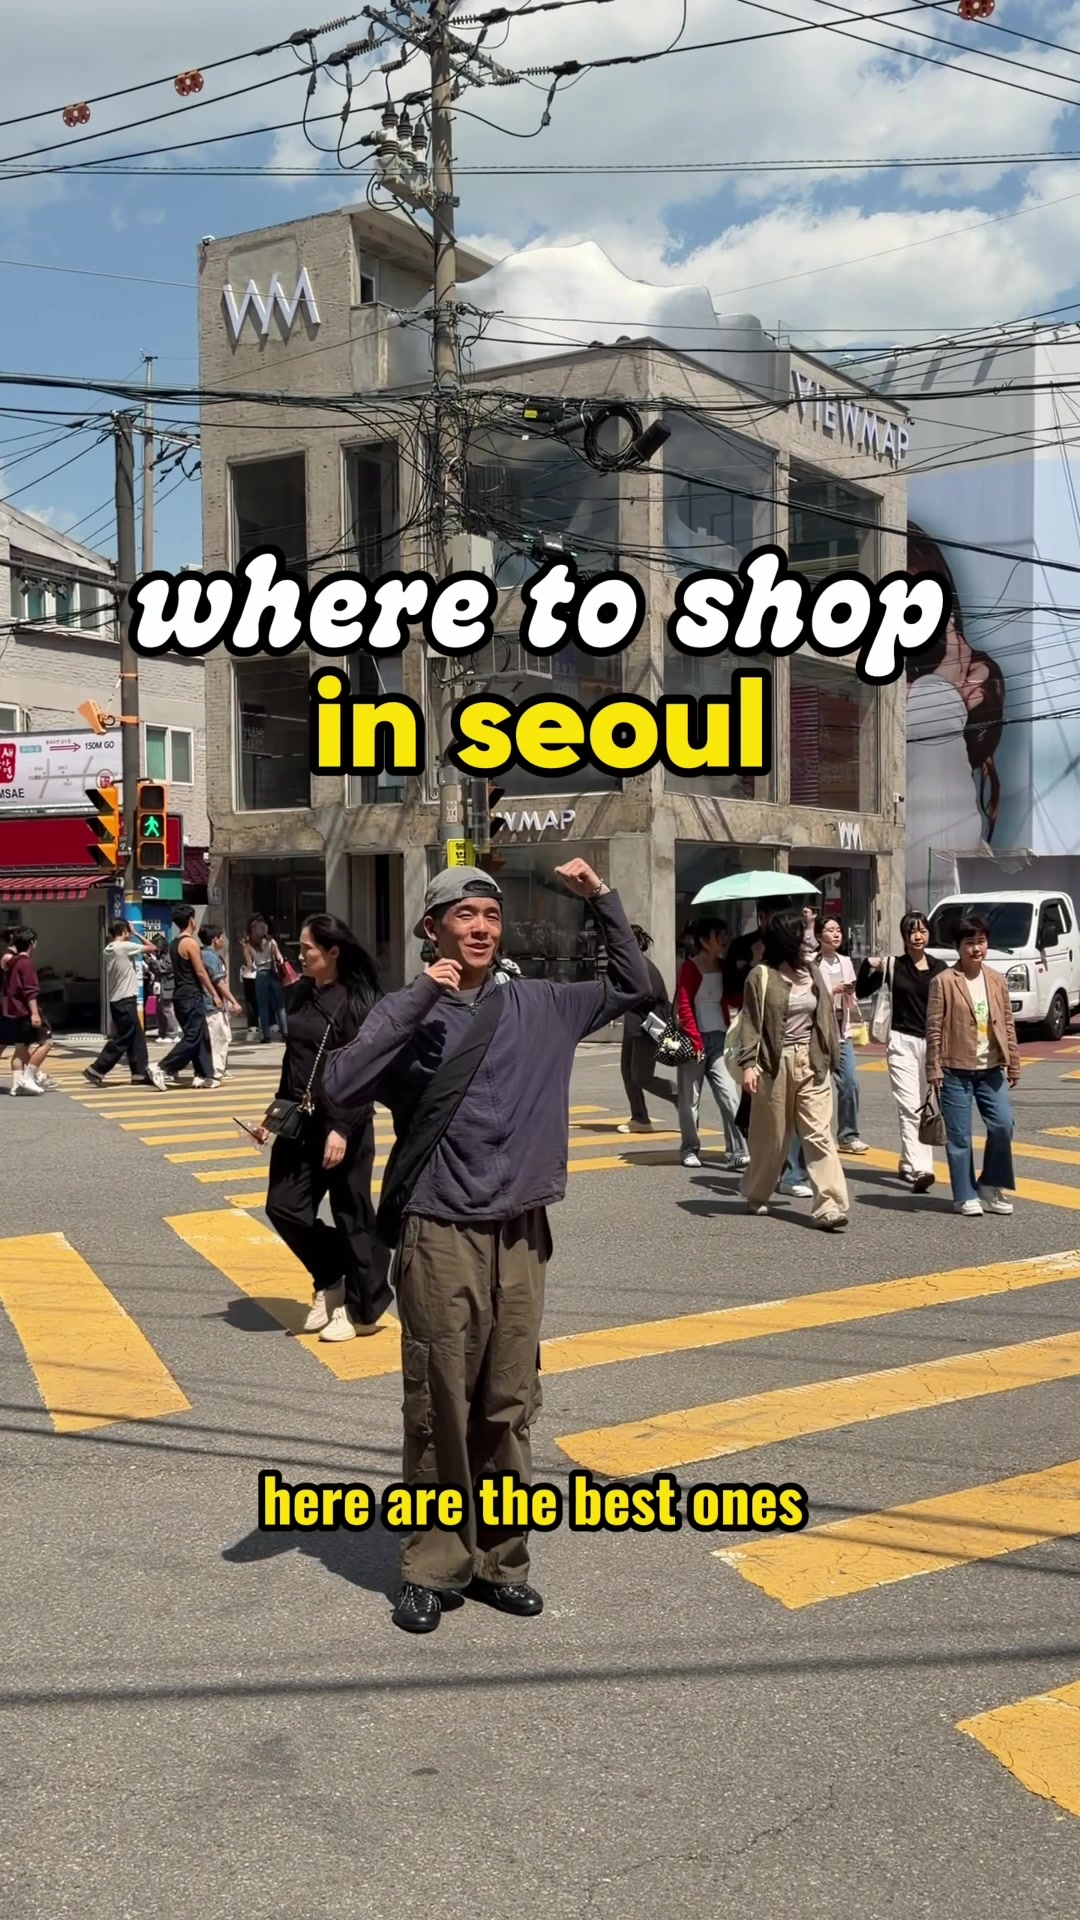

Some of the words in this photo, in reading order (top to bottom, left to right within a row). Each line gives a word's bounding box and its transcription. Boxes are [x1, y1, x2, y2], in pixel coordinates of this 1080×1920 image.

[795, 371, 910, 460] VIEWMAP
[85, 742, 102, 750] 150M
[104, 741, 115, 749] GO
[144, 886, 154, 896] 44
